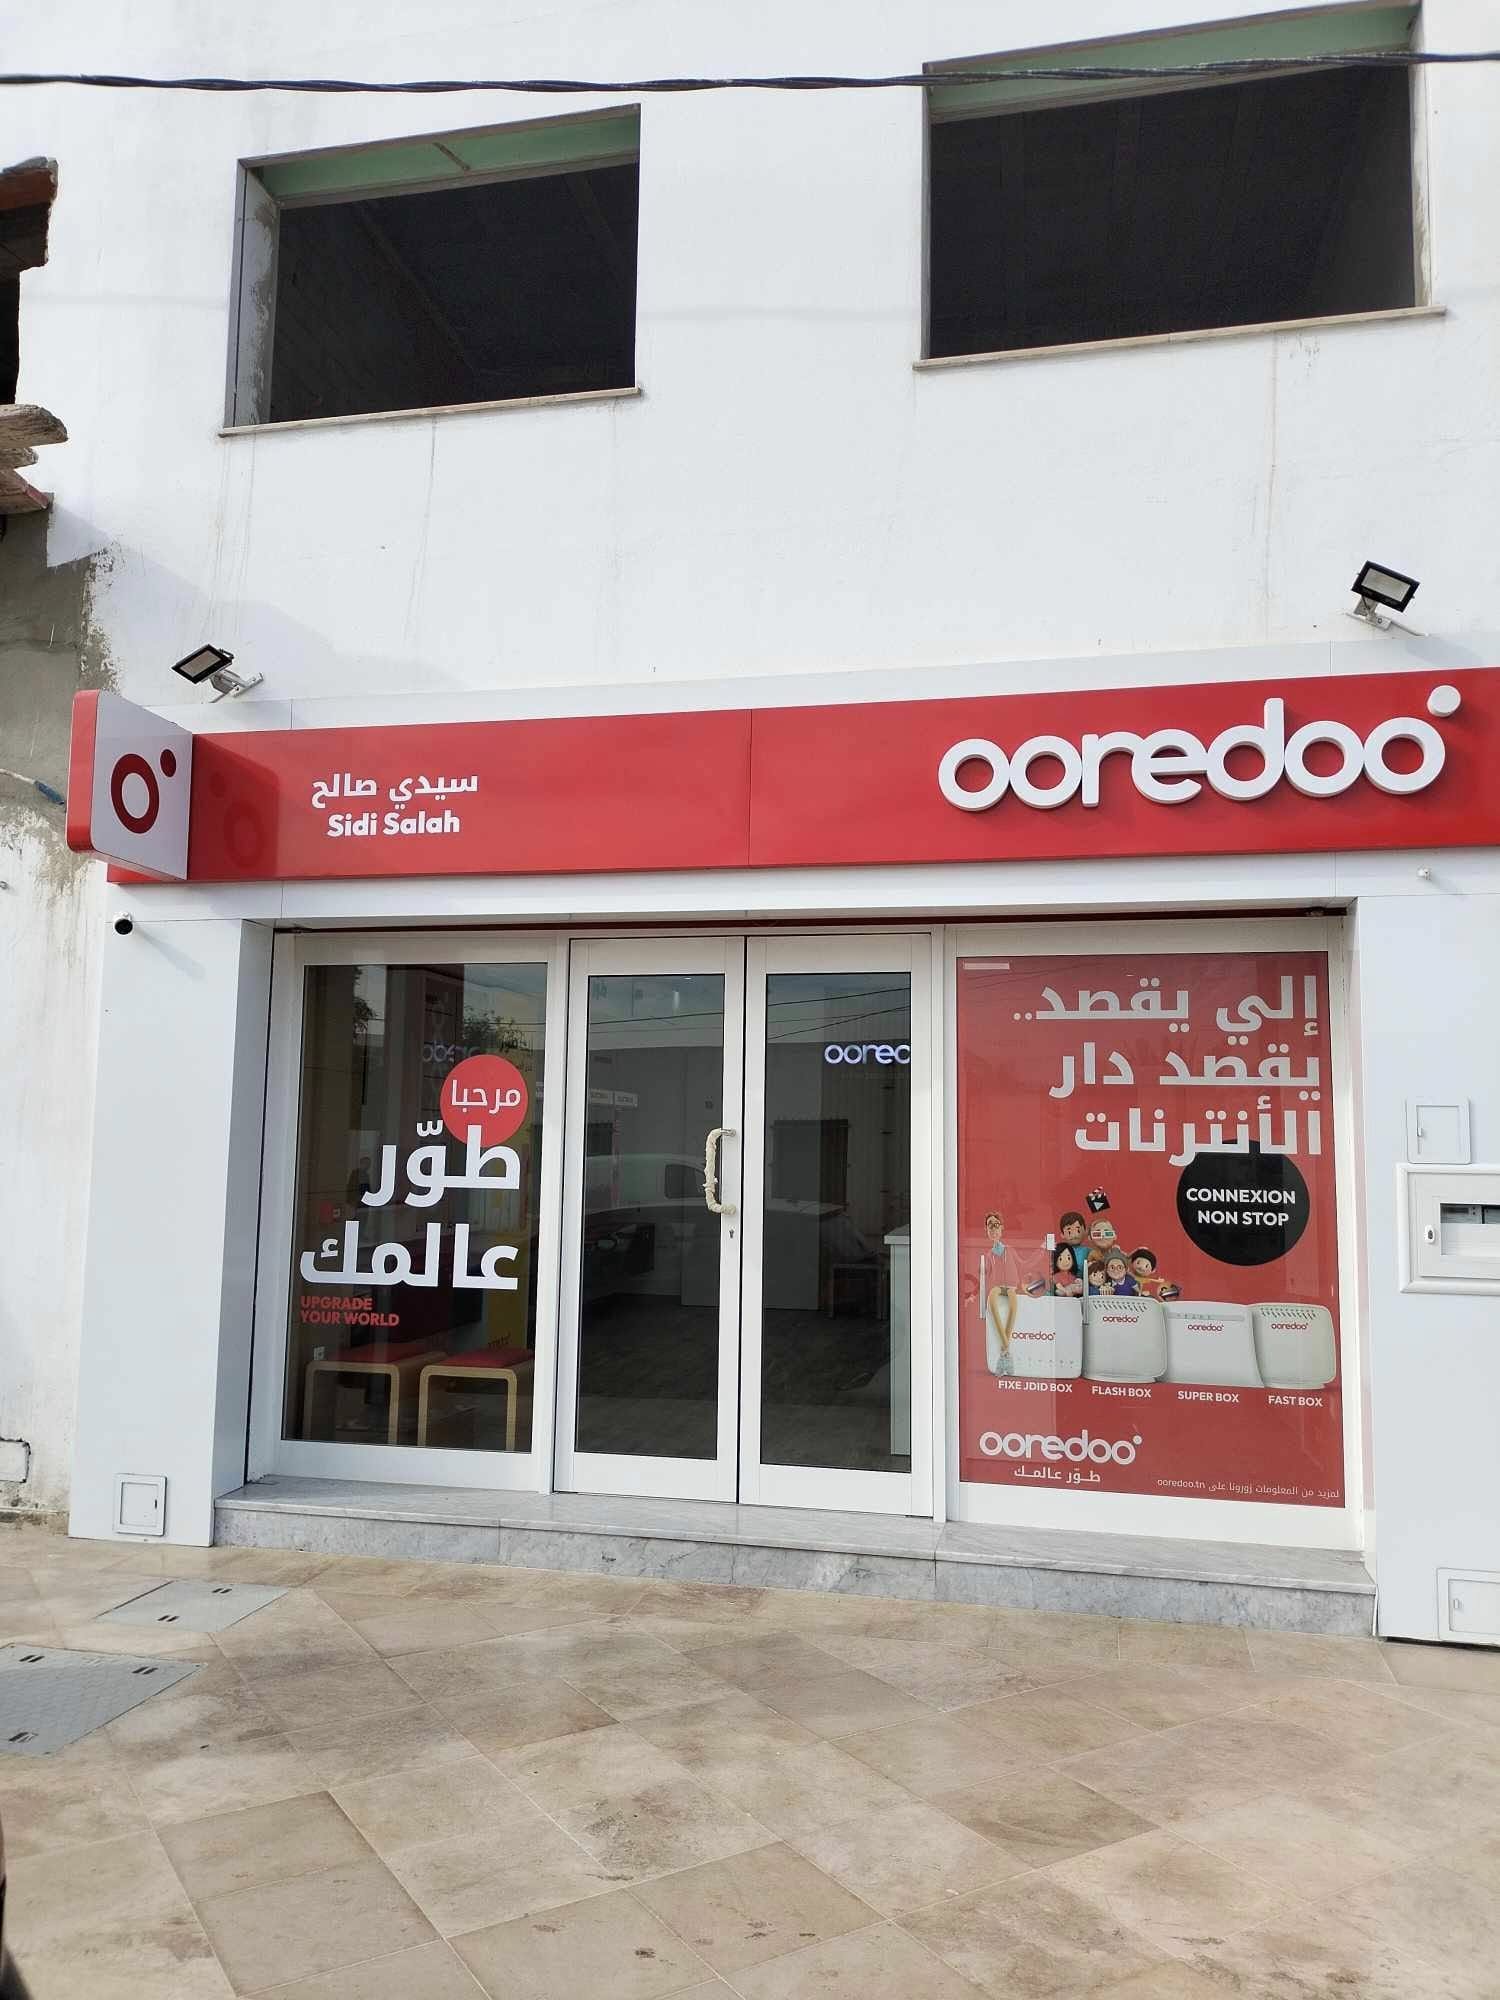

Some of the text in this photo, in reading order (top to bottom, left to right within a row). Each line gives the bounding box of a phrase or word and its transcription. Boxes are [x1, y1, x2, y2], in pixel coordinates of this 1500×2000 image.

[936, 684, 1461, 810] ooredoo
[312, 772, 477, 809] سيدي صالح
[327, 807, 459, 837] Sidi Salah
[1049, 1042, 1320, 1101] يقصد دار
[452, 1080, 520, 1114] مرحبا
[1187, 1188, 1295, 1204] CONNEXION
[1197, 1210, 1289, 1226] NON STOP
[300, 1221, 518, 1290] عالمك
[301, 1296, 372, 1312] UPGRADE
[301, 1309, 399, 1326] YOUR WORLD
[998, 1379, 1073, 1393] FIXE JDID BOX
[1091, 1385, 1152, 1398] FLASH BOX
[1177, 1390, 1240, 1403] SUPER BOX
[1268, 1395, 1324, 1407] FAST BOX
[980, 1430, 1142, 1464] ooredoo
[1157, 1479, 1206, 1489] ooredoo.tn
[1302, 1489, 1314, 1498] من
